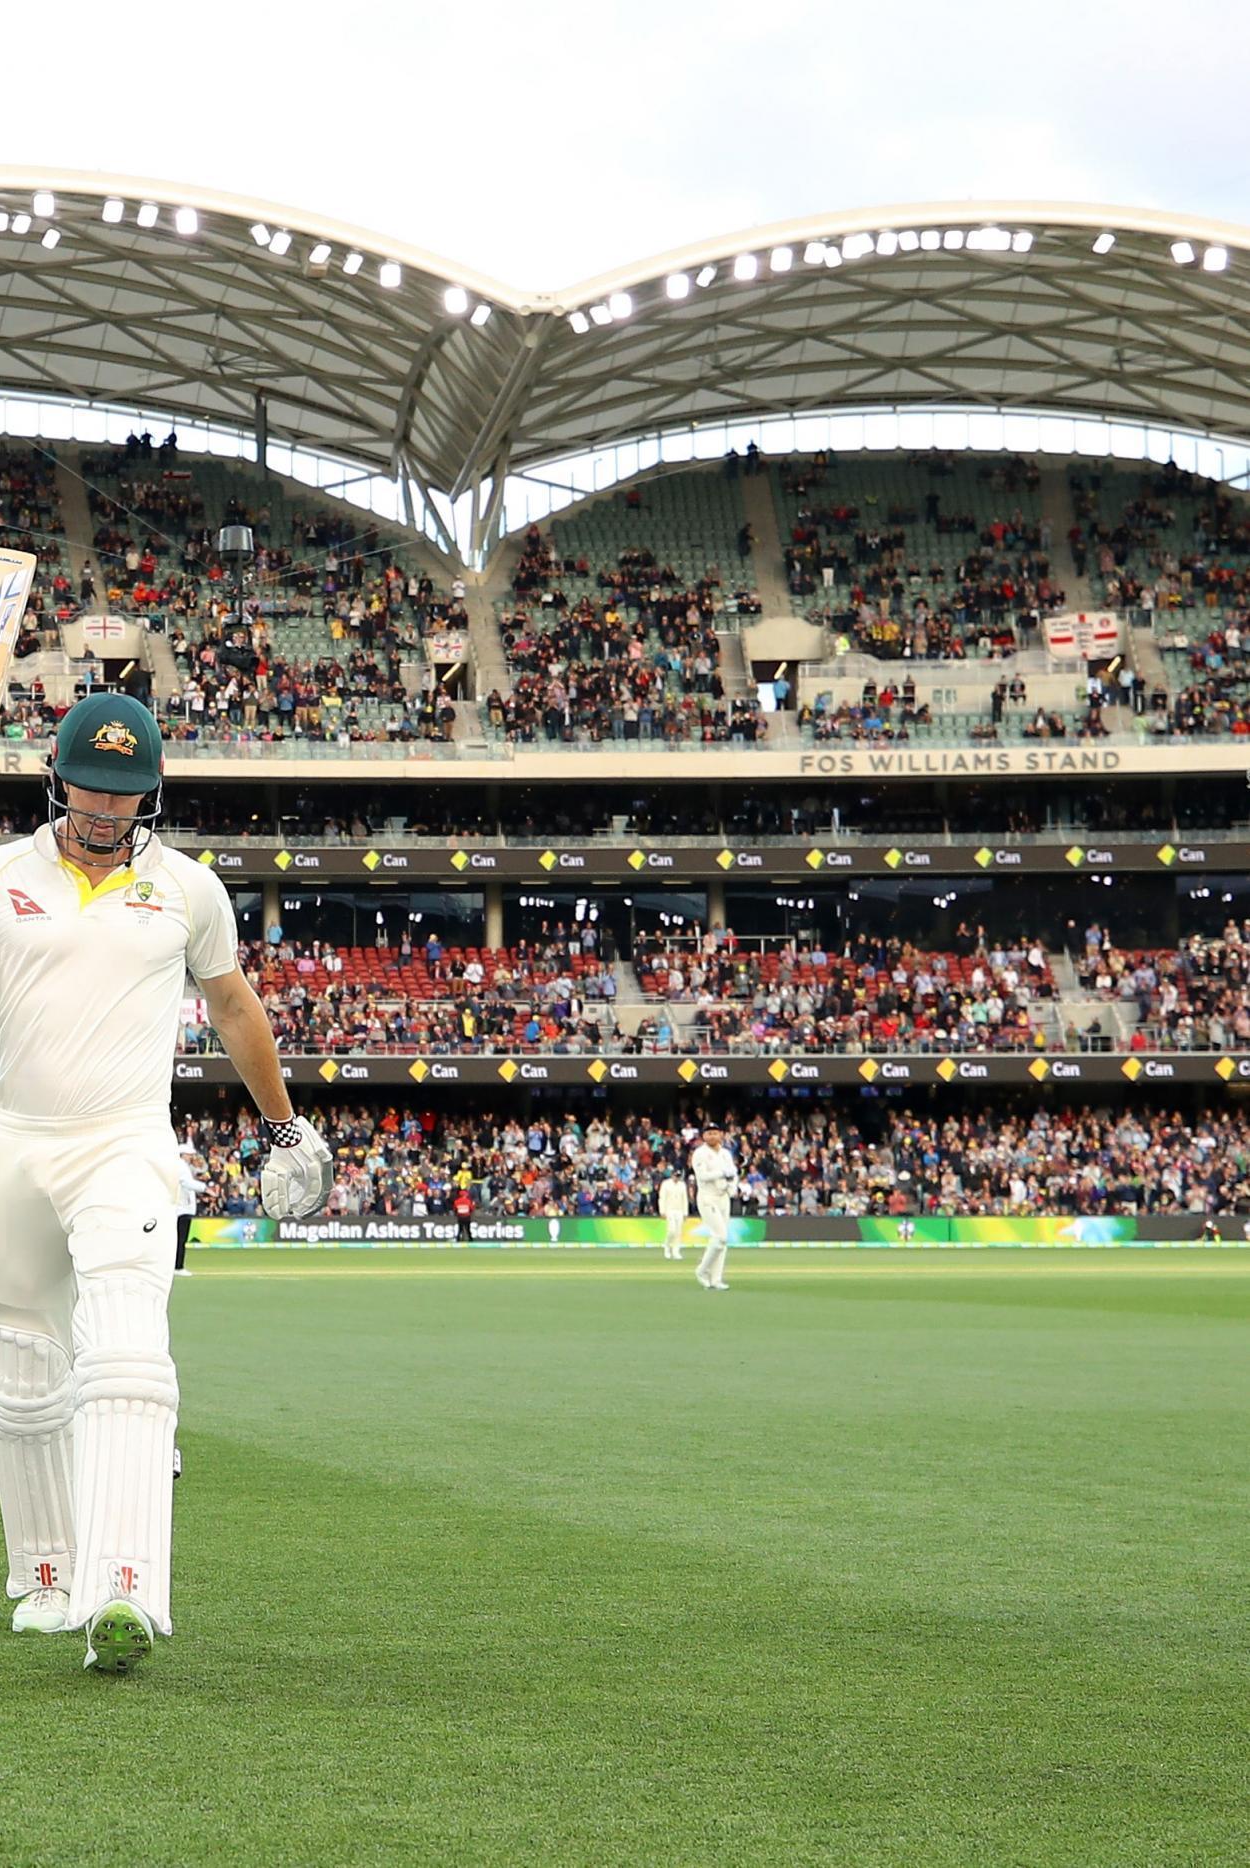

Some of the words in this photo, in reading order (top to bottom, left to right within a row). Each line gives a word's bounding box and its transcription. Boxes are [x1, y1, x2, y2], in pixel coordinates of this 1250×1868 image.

[800, 754, 854, 774] FOS
[868, 753, 1011, 772] WILLIAMS
[1025, 750, 1121, 771] STAND
[216, 853, 243, 867] Can
[293, 853, 320, 867] Can
[382, 853, 408, 867] Can
[469, 853, 496, 867] Can
[559, 853, 585, 867] Can
[646, 852, 673, 867] Can
[737, 852, 763, 866] Can
[826, 852, 852, 866] Can
[904, 851, 931, 865] Can
[995, 850, 1021, 864] Can
[1086, 849, 1113, 863] Can
[1178, 847, 1205, 862] Can
[176, 1063, 203, 1078] Can
[340, 1063, 369, 1079] Can
[430, 1063, 459, 1079] Can
[519, 1063, 548, 1078] Can
[610, 1062, 638, 1078] Can
[699, 1062, 728, 1078] Can
[790, 1062, 819, 1078] Can
[881, 1062, 910, 1078] Can
[959, 1061, 988, 1078] Can
[1052, 1061, 1081, 1077] Can
[1146, 1060, 1175, 1077] Can
[279, 1221, 363, 1243] Magellan
[365, 1221, 420, 1240] Ashes
[469, 1221, 524, 1239] Series
